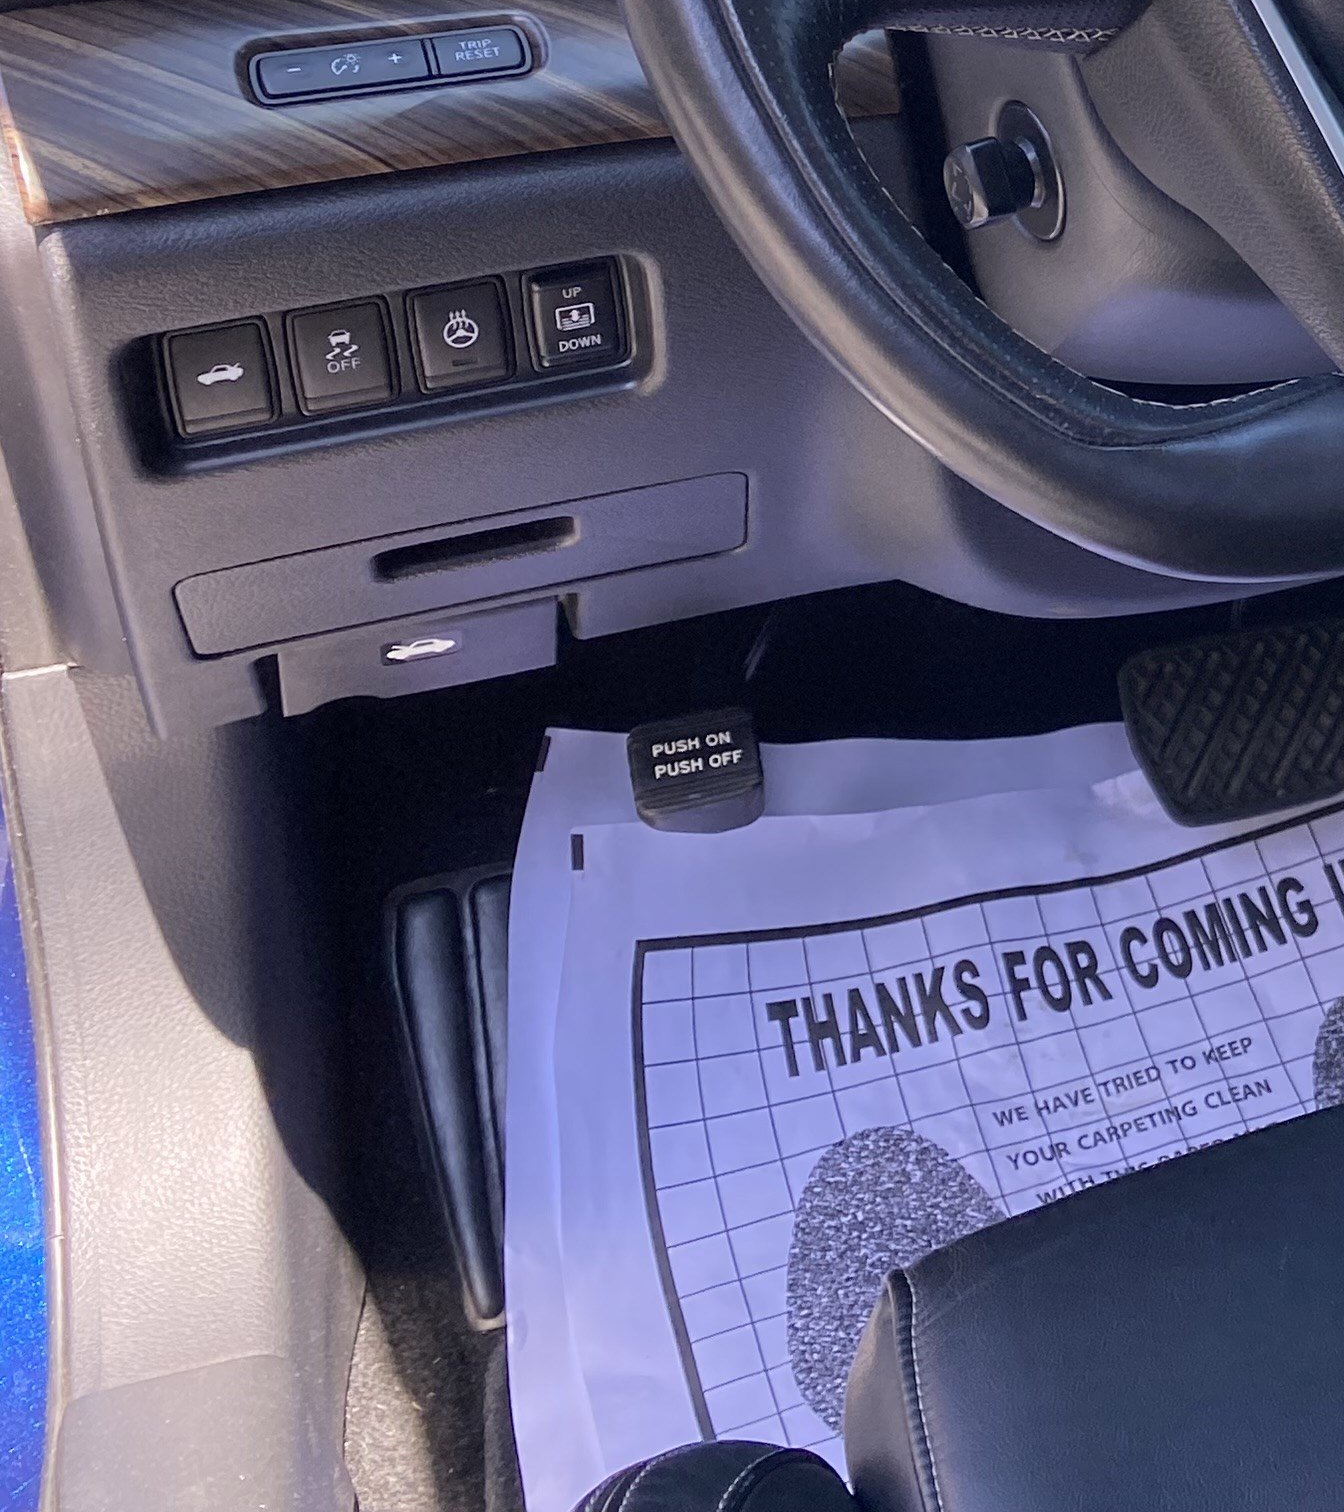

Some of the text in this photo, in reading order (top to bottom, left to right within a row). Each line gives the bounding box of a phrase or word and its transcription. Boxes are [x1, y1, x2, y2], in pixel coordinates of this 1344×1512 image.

[455, 47, 500, 61] RESET
[458, 38, 491, 50] TRIP
[561, 286, 582, 299] UP
[558, 334, 602, 352] DOWN
[326, 356, 362, 374] OFF
[651, 731, 731, 758] PUSH ON
[654, 748, 743, 780] PUSH OFF
[765, 958, 991, 1077] THANKS
[1001, 939, 1114, 1021] FOR
[1118, 876, 1320, 989] COMING
[992, 1037, 1253, 1127] WE HAVE TRIED TO KEEP
[1005, 1141, 1071, 1171] YOUR
[1077, 1100, 1199, 1151] CARPETING
[1203, 1079, 1273, 1109] CLEAN
[1036, 1175, 1095, 1204] WITH
